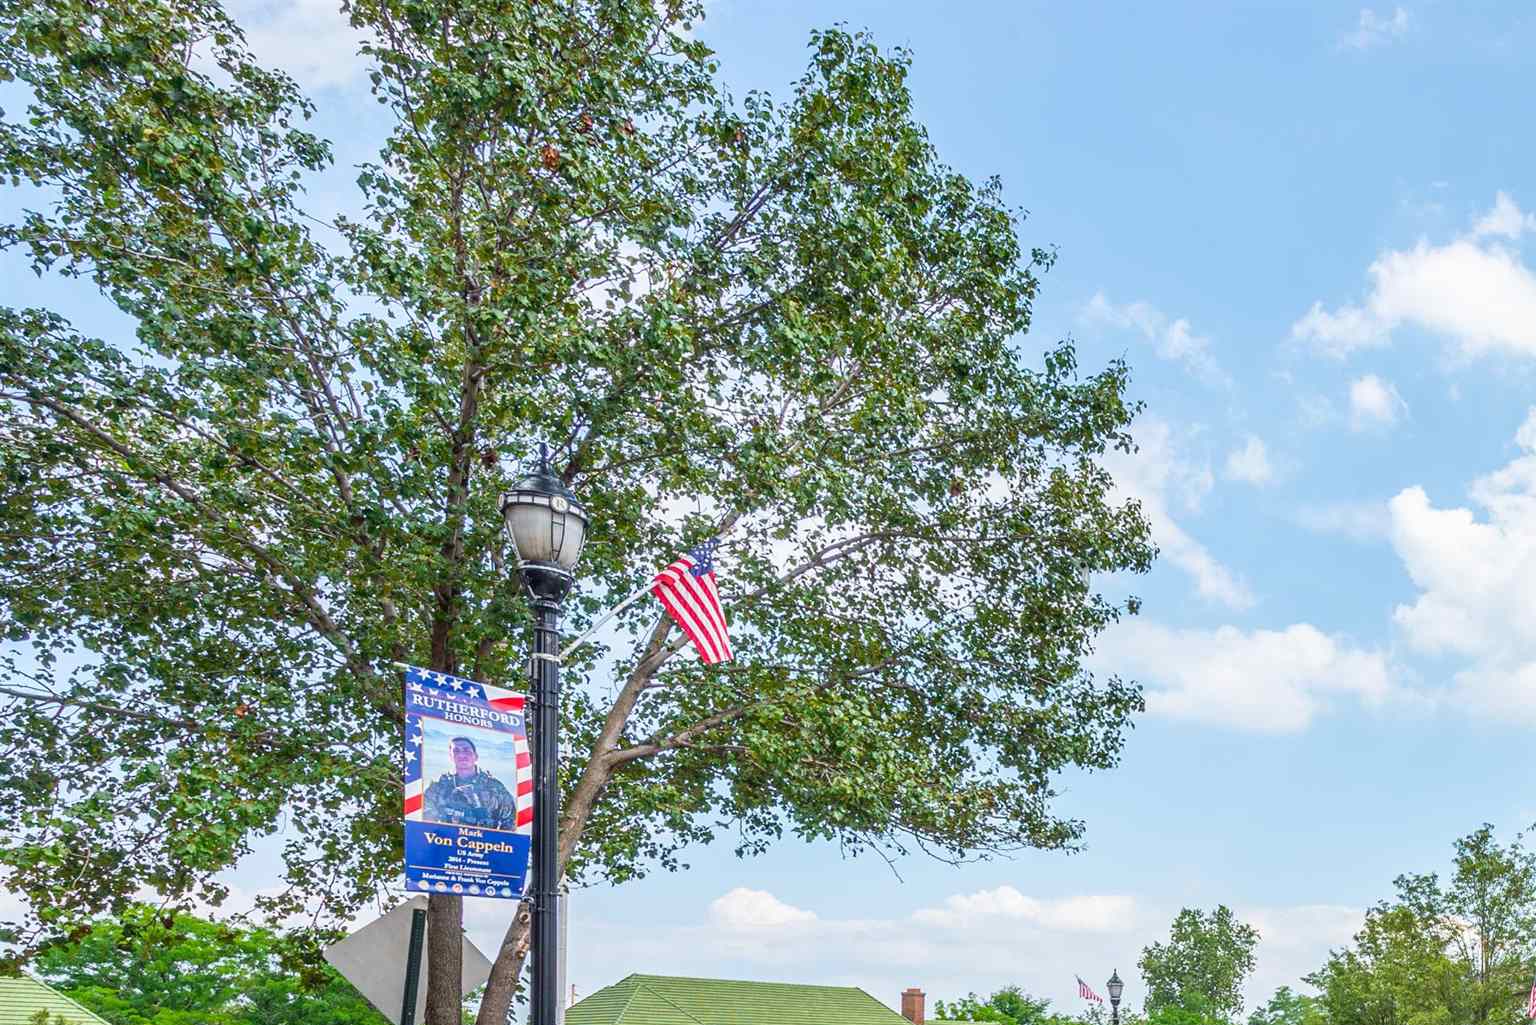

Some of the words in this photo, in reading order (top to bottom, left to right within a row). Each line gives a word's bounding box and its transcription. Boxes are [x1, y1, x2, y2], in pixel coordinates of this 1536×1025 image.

[412, 693, 520, 726] RUTHERFORD
[445, 712, 493, 728] HONORS
[424, 832, 452, 847] Von
[458, 827, 483, 838] Mark
